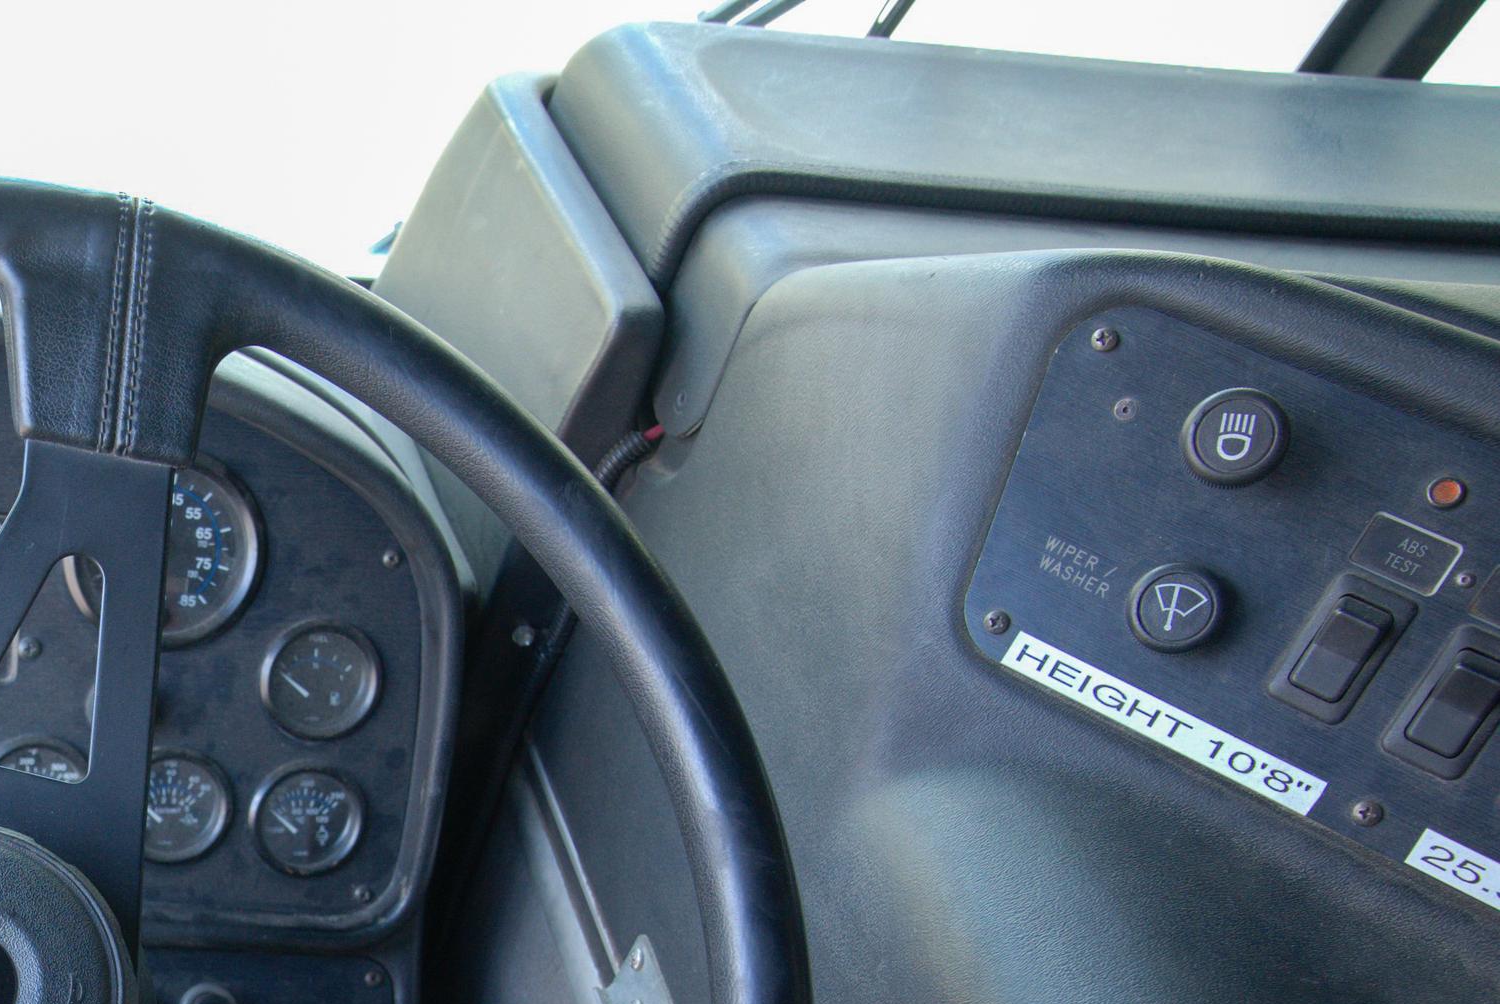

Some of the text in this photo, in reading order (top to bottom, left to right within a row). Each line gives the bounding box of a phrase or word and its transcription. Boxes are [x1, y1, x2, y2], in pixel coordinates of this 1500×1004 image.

[185, 507, 202, 520] 55
[196, 527, 213, 540] 65
[1044, 535, 1100, 570] WIPER
[1398, 537, 1429, 558] ABS
[196, 557, 212, 570] 75
[1385, 551, 1420, 576] TEST
[1039, 555, 1111, 599] WASHER
[180, 594, 197, 607] 85
[1016, 645, 1313, 797] HEIGHT 10'8"
[1420, 845, 1500, 897] 25.
